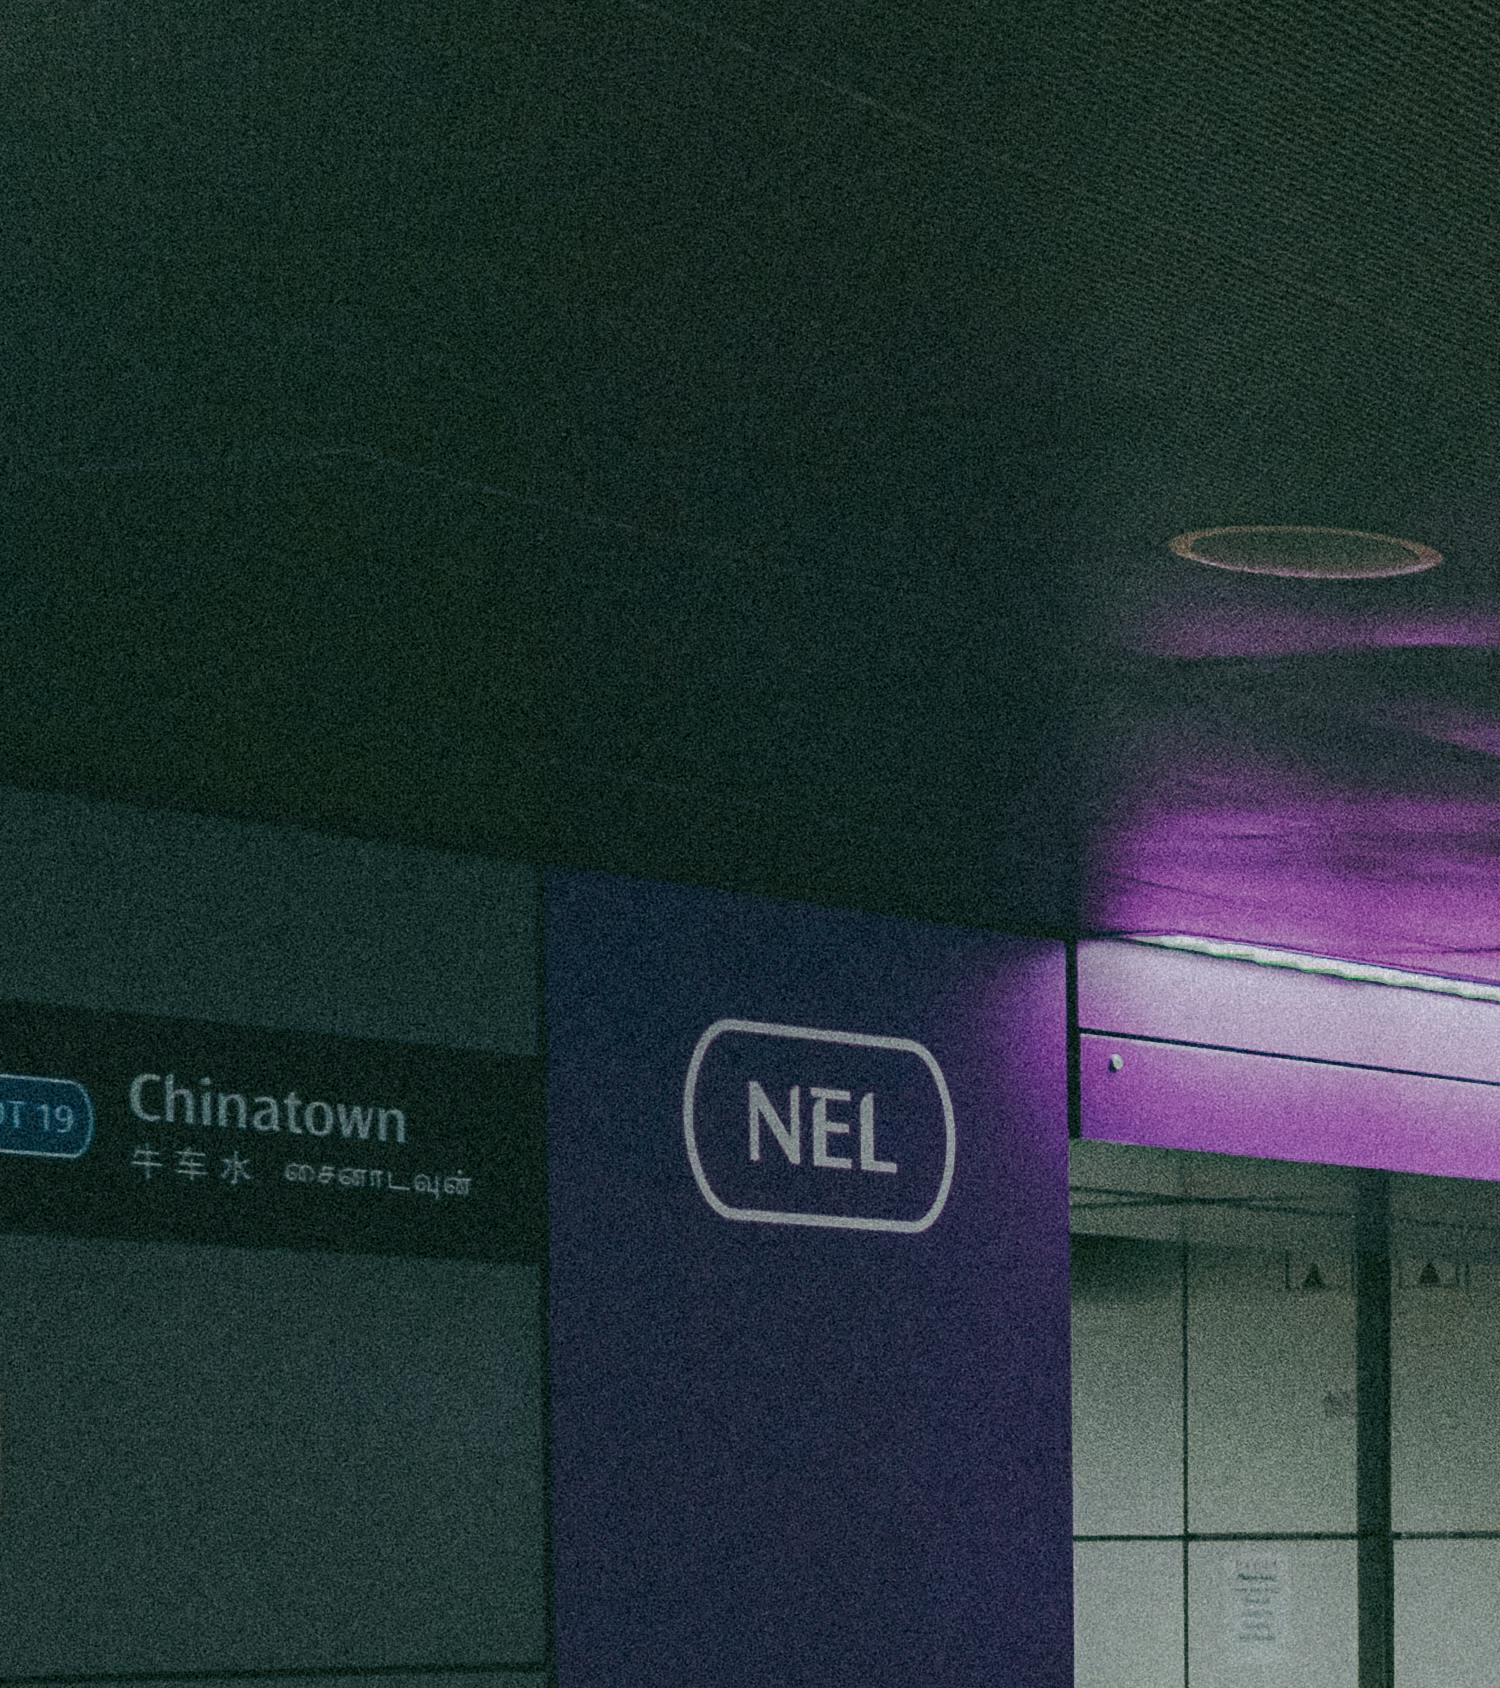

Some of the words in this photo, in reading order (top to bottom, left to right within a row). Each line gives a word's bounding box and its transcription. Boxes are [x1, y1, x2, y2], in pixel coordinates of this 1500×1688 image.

[40, 1104, 74, 1134] 19
[128, 1071, 408, 1145] Chinatown
[747, 1079, 899, 1174] NEL
[130, 1142, 254, 1186] 牛车水
